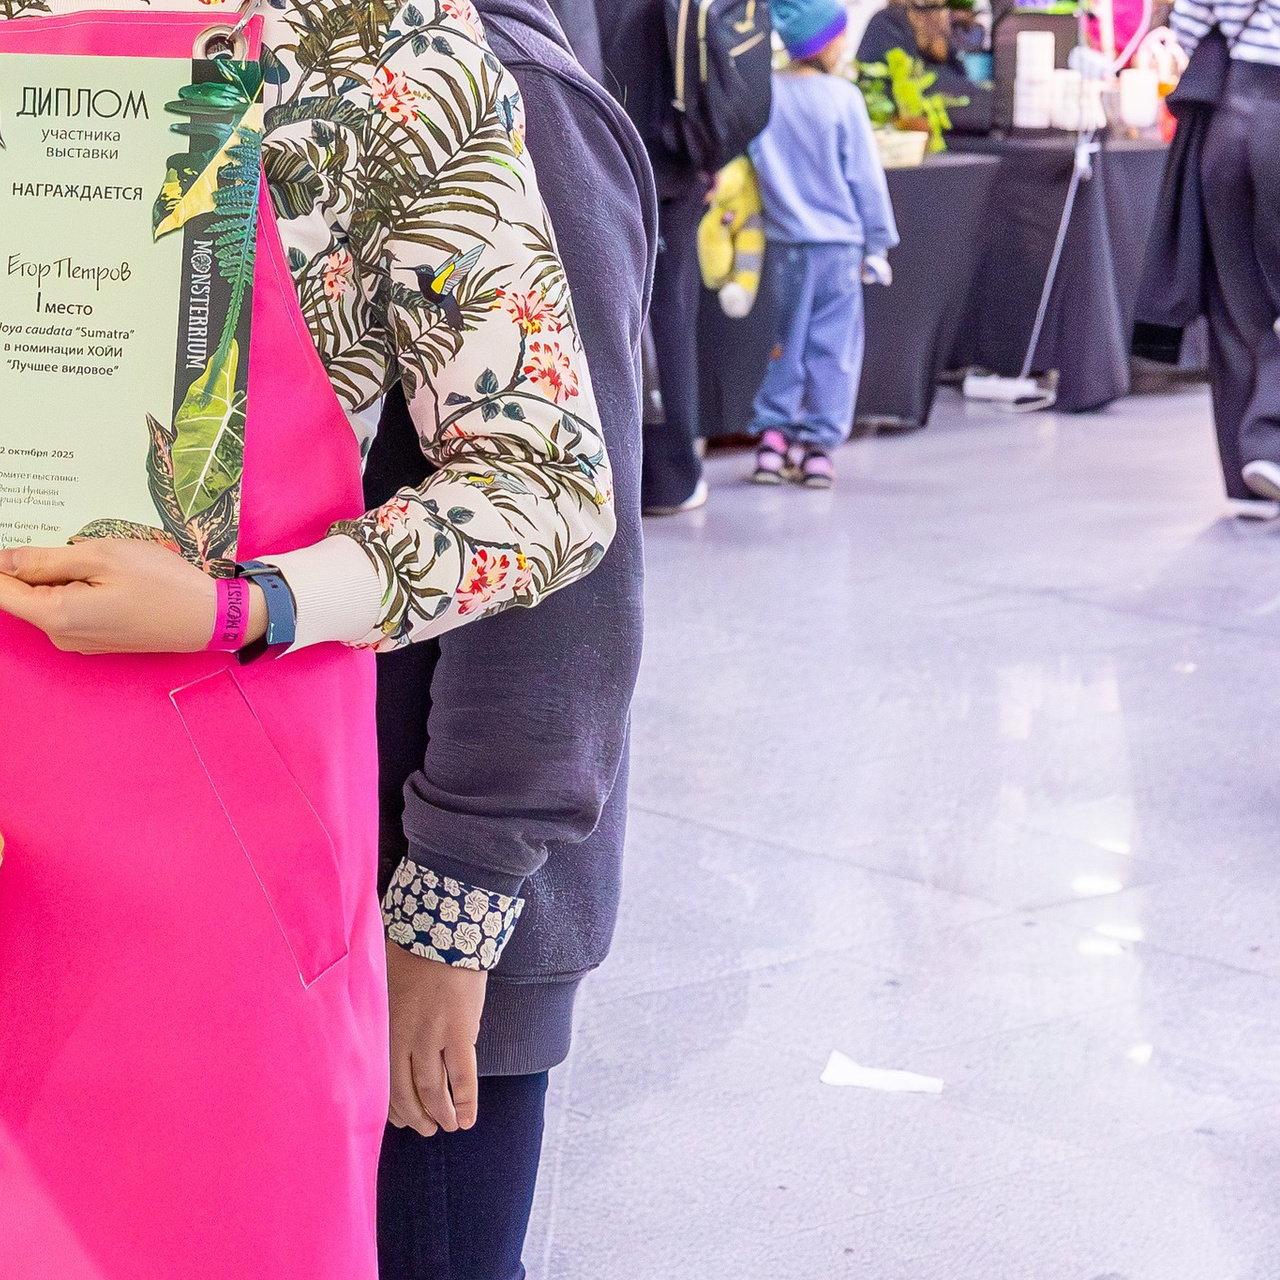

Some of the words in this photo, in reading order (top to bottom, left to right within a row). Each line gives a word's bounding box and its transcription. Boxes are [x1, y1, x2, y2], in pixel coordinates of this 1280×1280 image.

[16, 86, 149, 120] ДИПЛОМ
[41, 128, 121, 143] участника
[46, 147, 119, 159] выставки
[12, 182, 143, 201] НАГРАЖДАЕТСЯ
[7, 253, 51, 288] Егор
[53, 257, 132, 291] Петров
[44, 302, 93, 316] место
[25, 325, 73, 337] caudata
[3, 343, 11, 351] в
[14, 343, 84, 356] номинации
[87, 345, 123, 358] ХОЙИ
[8, 448, 49, 459] октября
[51, 450, 75, 459] 2025
